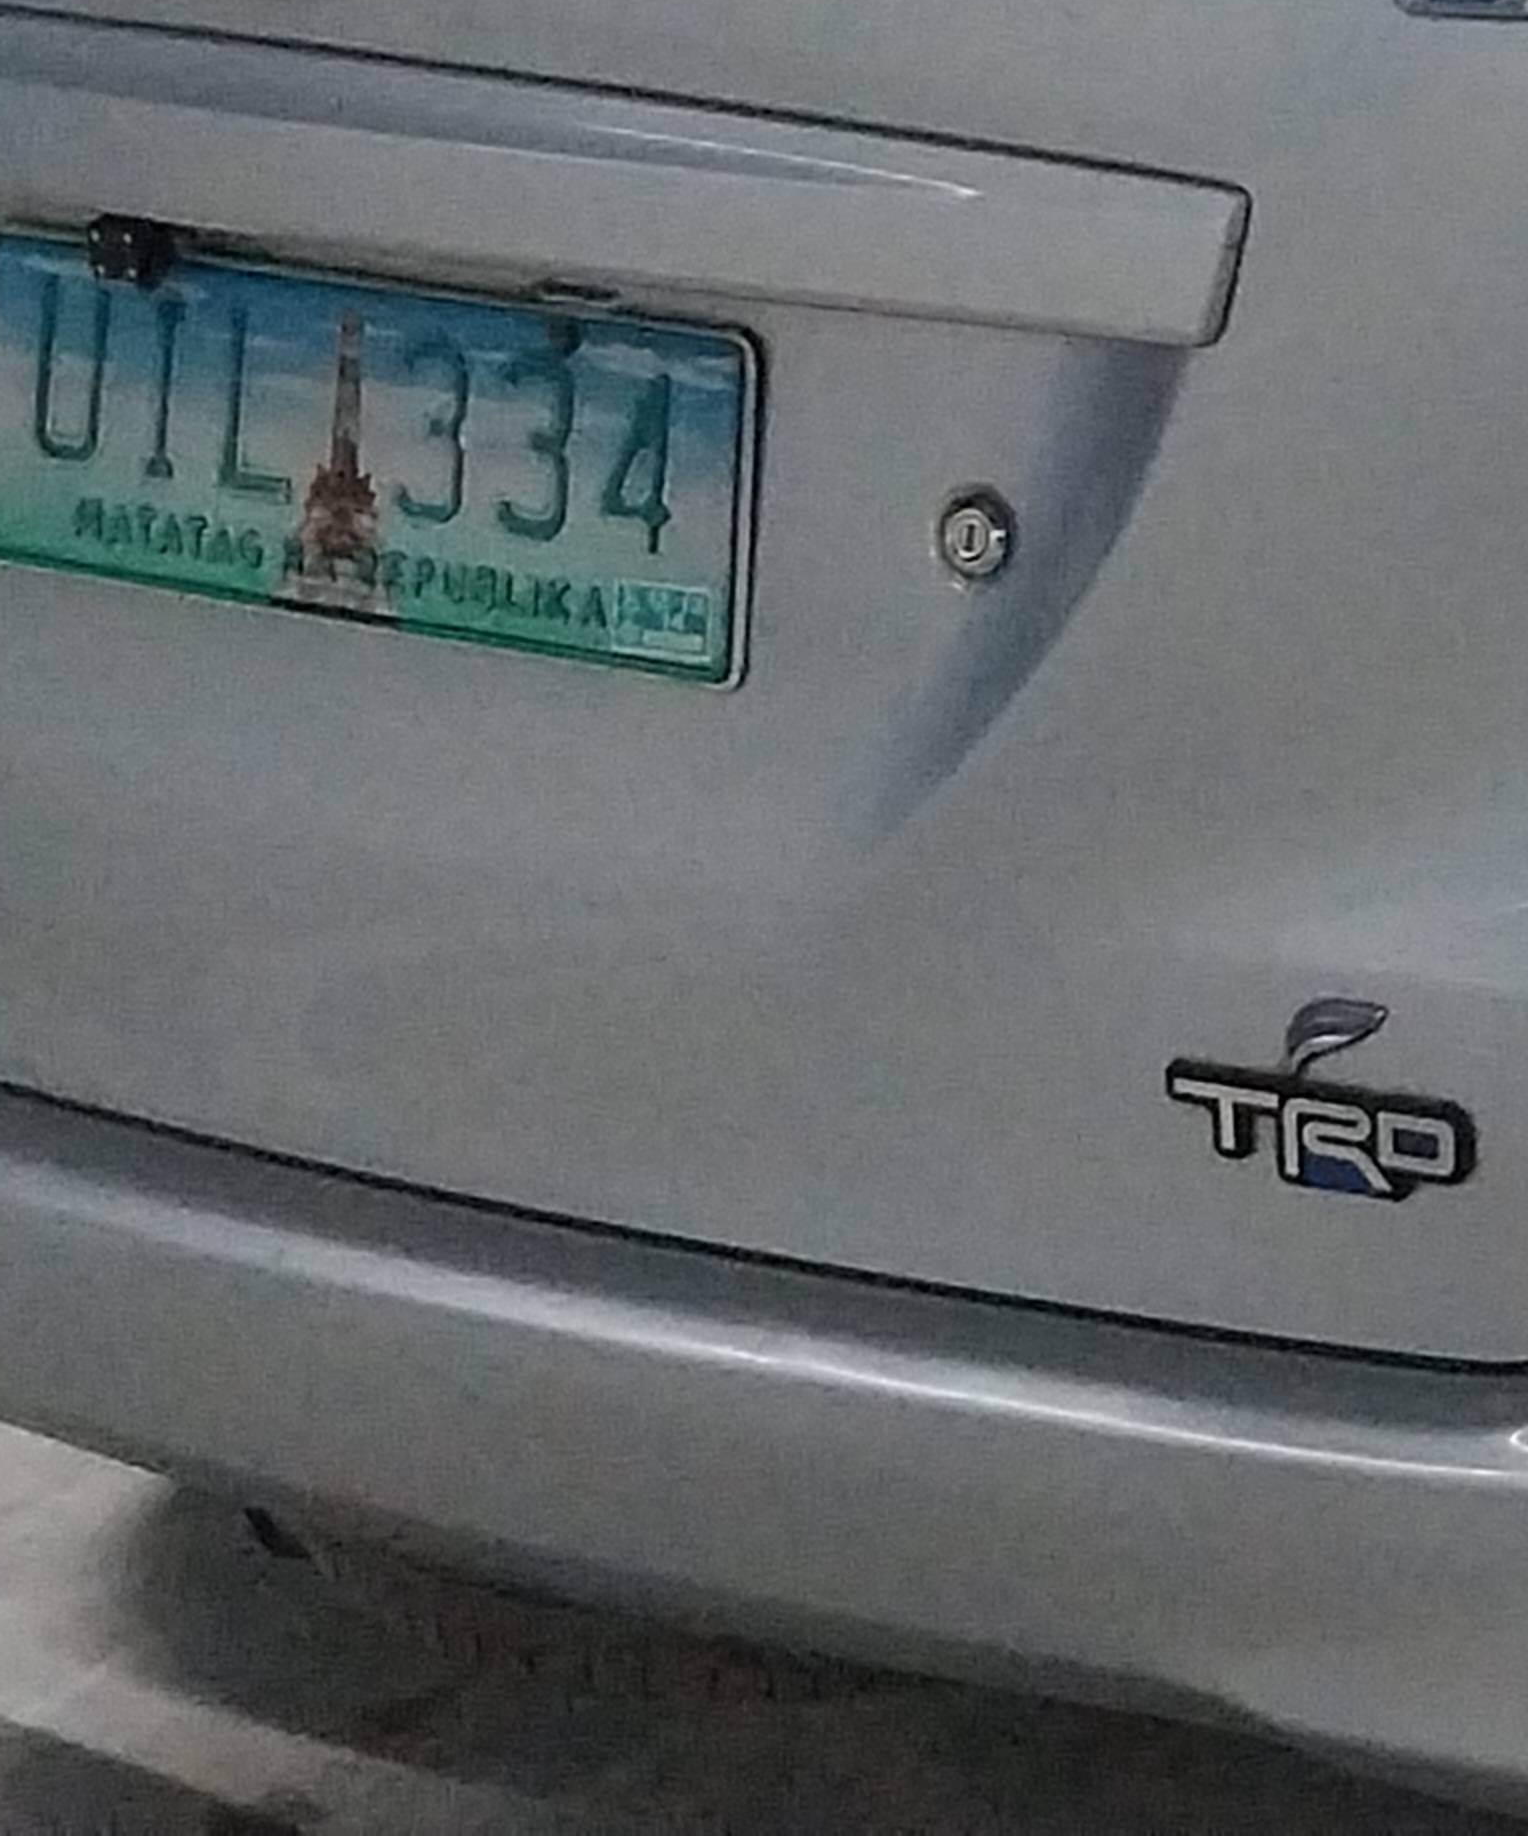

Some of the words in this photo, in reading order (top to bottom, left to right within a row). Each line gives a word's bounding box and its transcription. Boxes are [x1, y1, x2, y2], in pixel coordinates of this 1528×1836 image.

[35, 272, 292, 502] UIL
[394, 326, 673, 555] 334
[75, 497, 266, 571] MATATAG
[1170, 1070, 1464, 1196] TRD
